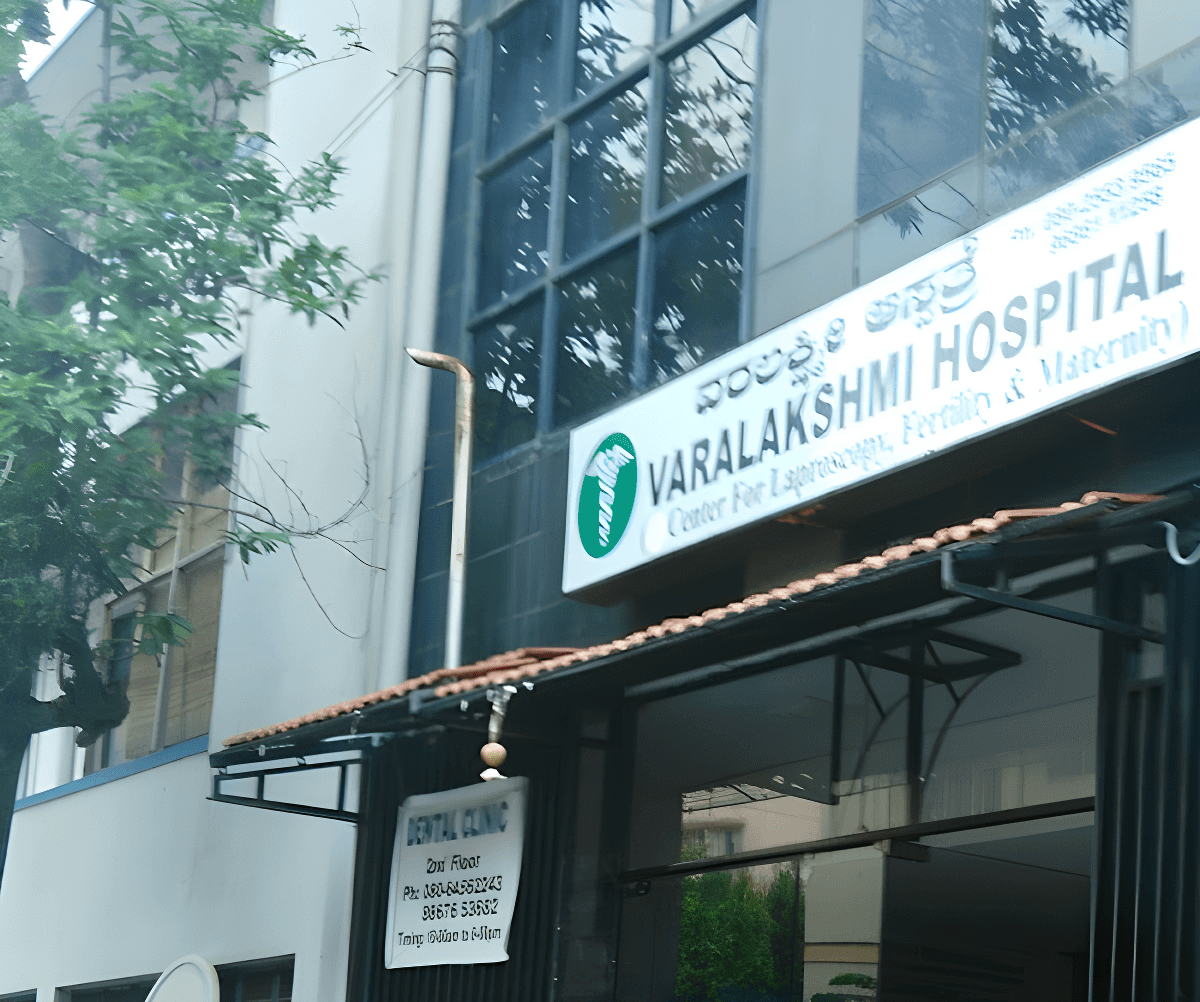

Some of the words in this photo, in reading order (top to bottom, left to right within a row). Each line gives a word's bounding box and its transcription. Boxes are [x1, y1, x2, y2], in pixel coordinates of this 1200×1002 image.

[647, 348, 912, 506] VARALAKSHMI
[931, 230, 1183, 388] HOSPITAL
[406, 810, 457, 846] DENTAL
[461, 800, 508, 838] CLINIC
[449, 852, 481, 871] Floor
